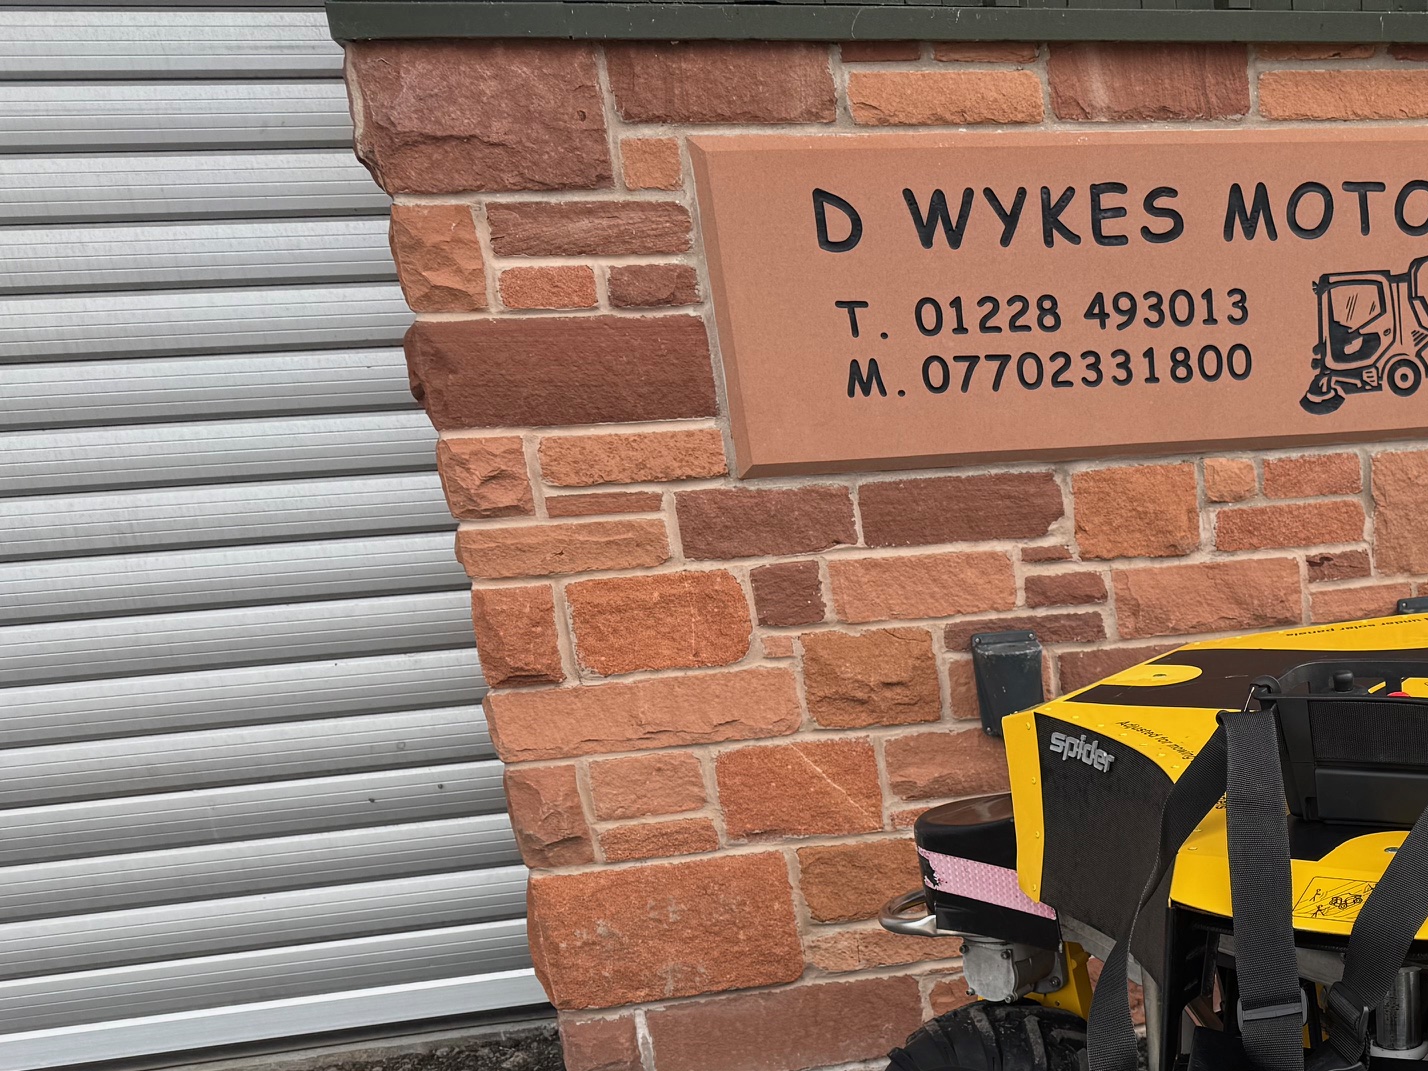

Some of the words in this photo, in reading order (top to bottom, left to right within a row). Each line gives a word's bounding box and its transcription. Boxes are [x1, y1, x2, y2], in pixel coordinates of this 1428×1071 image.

[812, 187, 863, 253] D
[902, 181, 1184, 250] WYKES
[834, 300, 889, 338] T.
[914, 294, 1063, 337] 01228
[1083, 287, 1249, 332] 493013
[1050, 732, 1116, 773] spider
